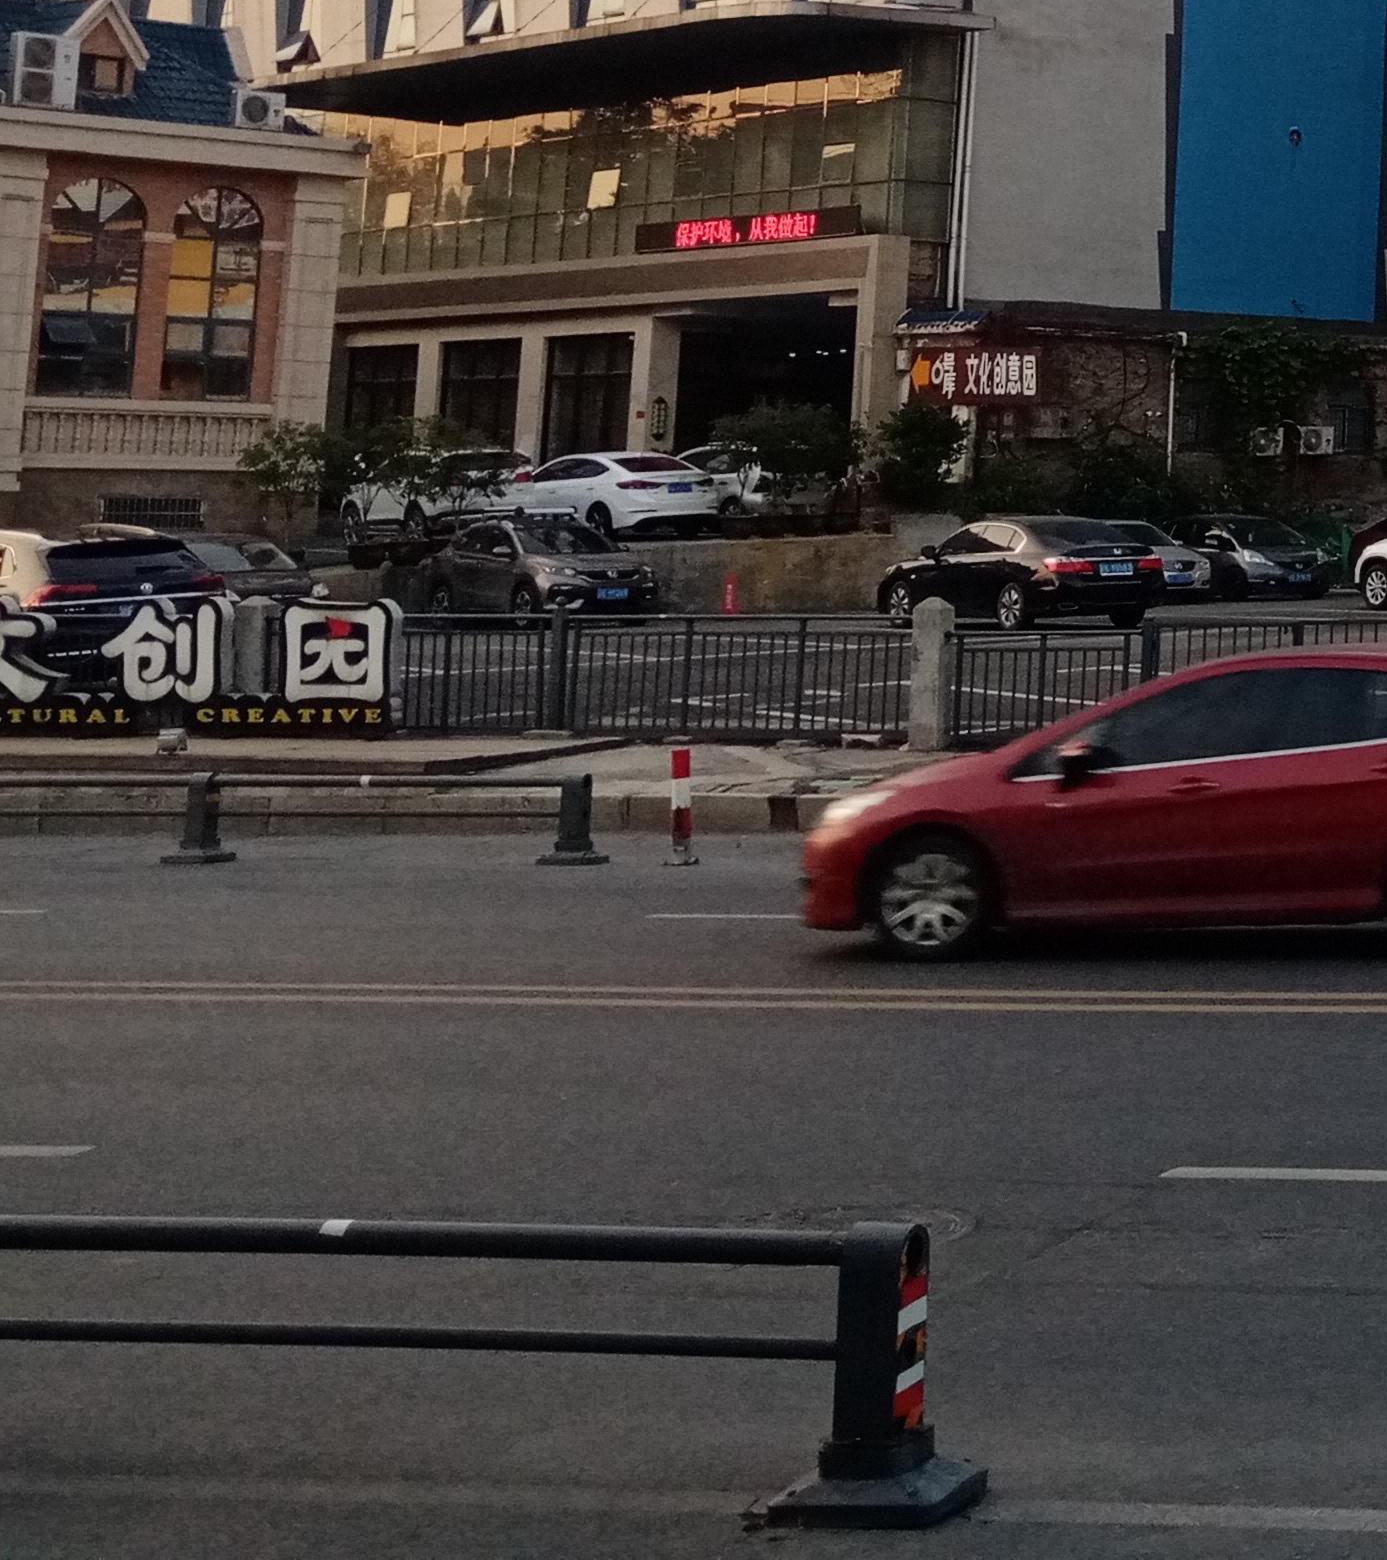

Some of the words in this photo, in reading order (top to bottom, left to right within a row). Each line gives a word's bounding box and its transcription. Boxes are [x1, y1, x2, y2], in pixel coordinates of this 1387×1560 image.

[964, 352, 1036, 396] 文化创意园
[196, 707, 383, 724] CREATIVE
